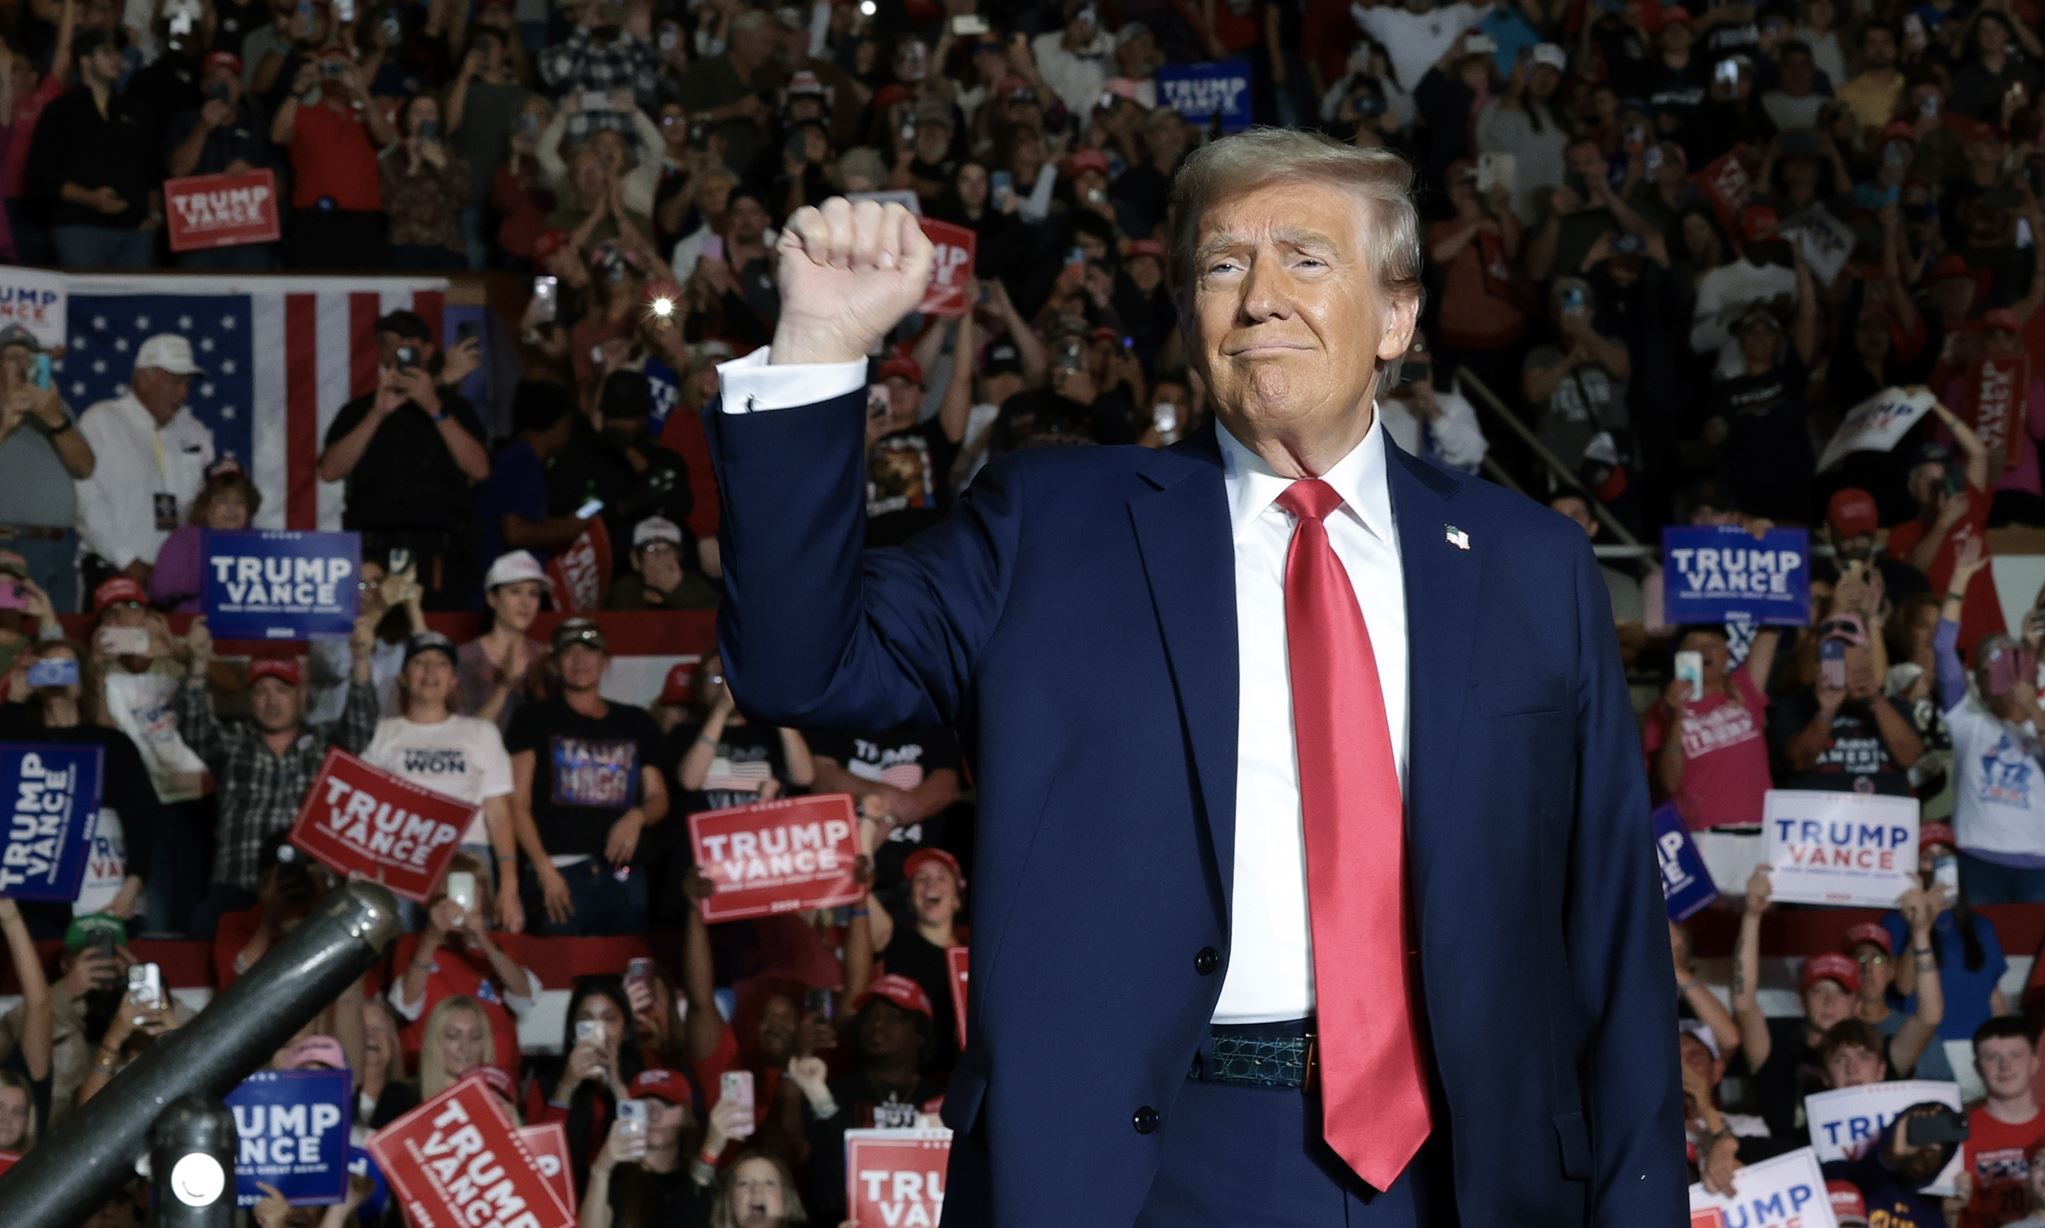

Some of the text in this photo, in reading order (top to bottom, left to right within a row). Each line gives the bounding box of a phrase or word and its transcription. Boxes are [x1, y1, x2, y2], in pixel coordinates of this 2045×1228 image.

[172, 185, 270, 215] TRUMP
[0, 287, 57, 303] UMP
[0, 304, 45, 321] NCE
[209, 556, 353, 584] TRUMP
[1670, 547, 1802, 574] TRUMP
[225, 580, 337, 605] VANCE
[1686, 570, 1788, 593] VANCE
[405, 757, 465, 773] WON
[0, 751, 46, 892] TRUMP
[25, 769, 68, 877] VANCE
[323, 775, 460, 849] TRUMP
[329, 805, 433, 866] VANCE
[702, 819, 850, 863] TRUMP
[1775, 819, 1909, 849] TRUMP
[723, 848, 839, 882] VANCE
[1788, 845, 1896, 870] VANCE
[232, 1103, 341, 1137] UMP
[1822, 1112, 1900, 1145] TRU
[236, 1135, 321, 1164] NCE
[433, 1097, 541, 1228] TRUMP
[860, 1169, 946, 1202] TRU
[1722, 1184, 1812, 1228] UMP
